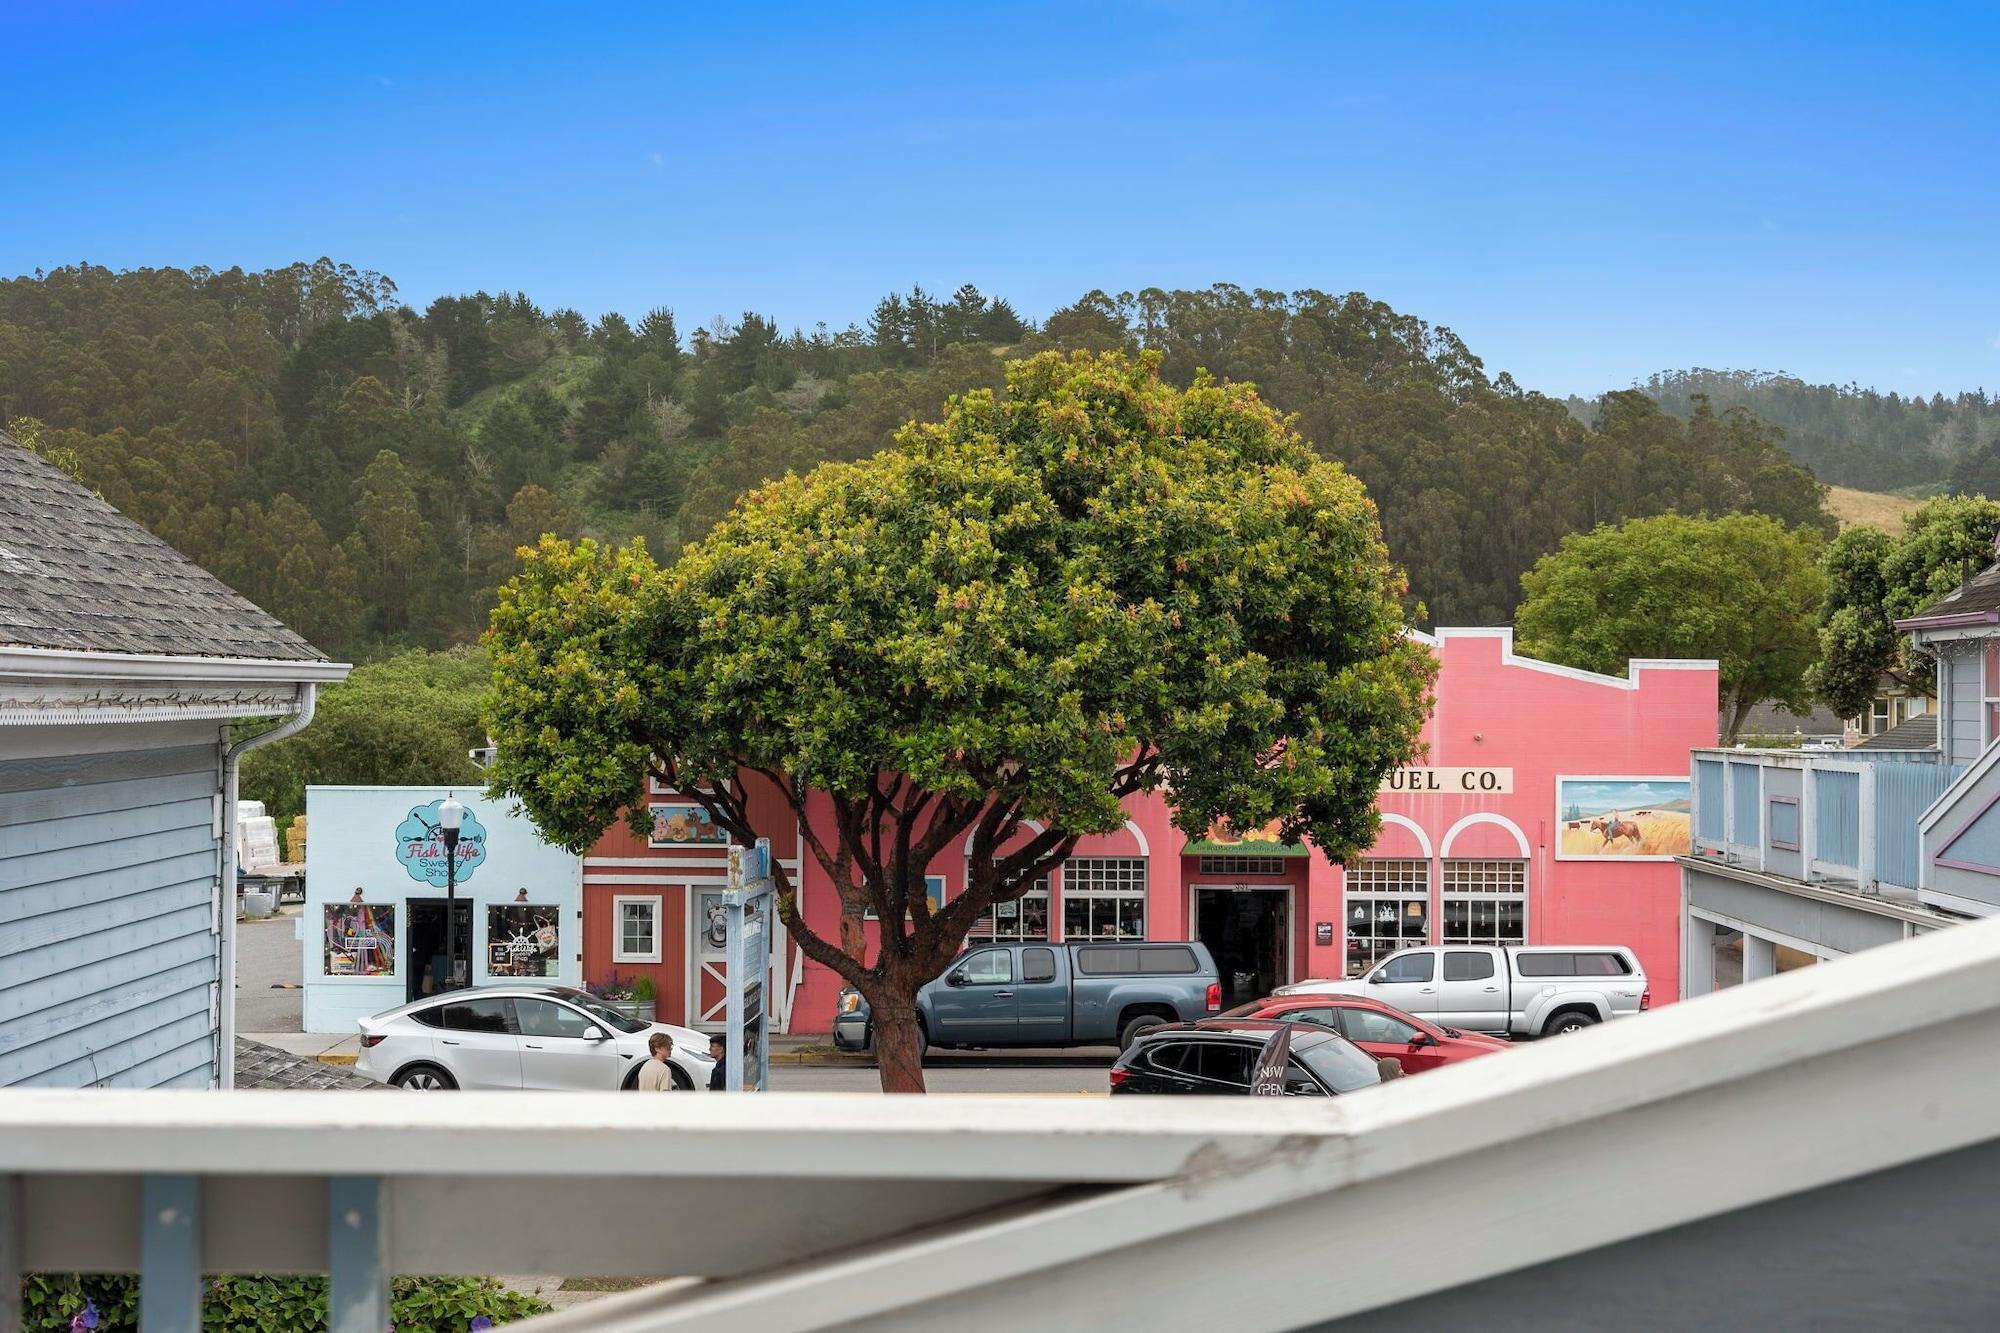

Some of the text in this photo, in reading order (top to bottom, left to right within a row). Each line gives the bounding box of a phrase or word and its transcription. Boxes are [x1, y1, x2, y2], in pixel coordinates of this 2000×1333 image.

[1390, 771, 1502, 790] UEL CO.
[405, 842, 440, 859] Fish
[419, 858, 463, 868] Swees
[425, 867, 449, 877] Sho
[1260, 1066, 1284, 1078] NOW
[1257, 1083, 1284, 1096] OPEN
